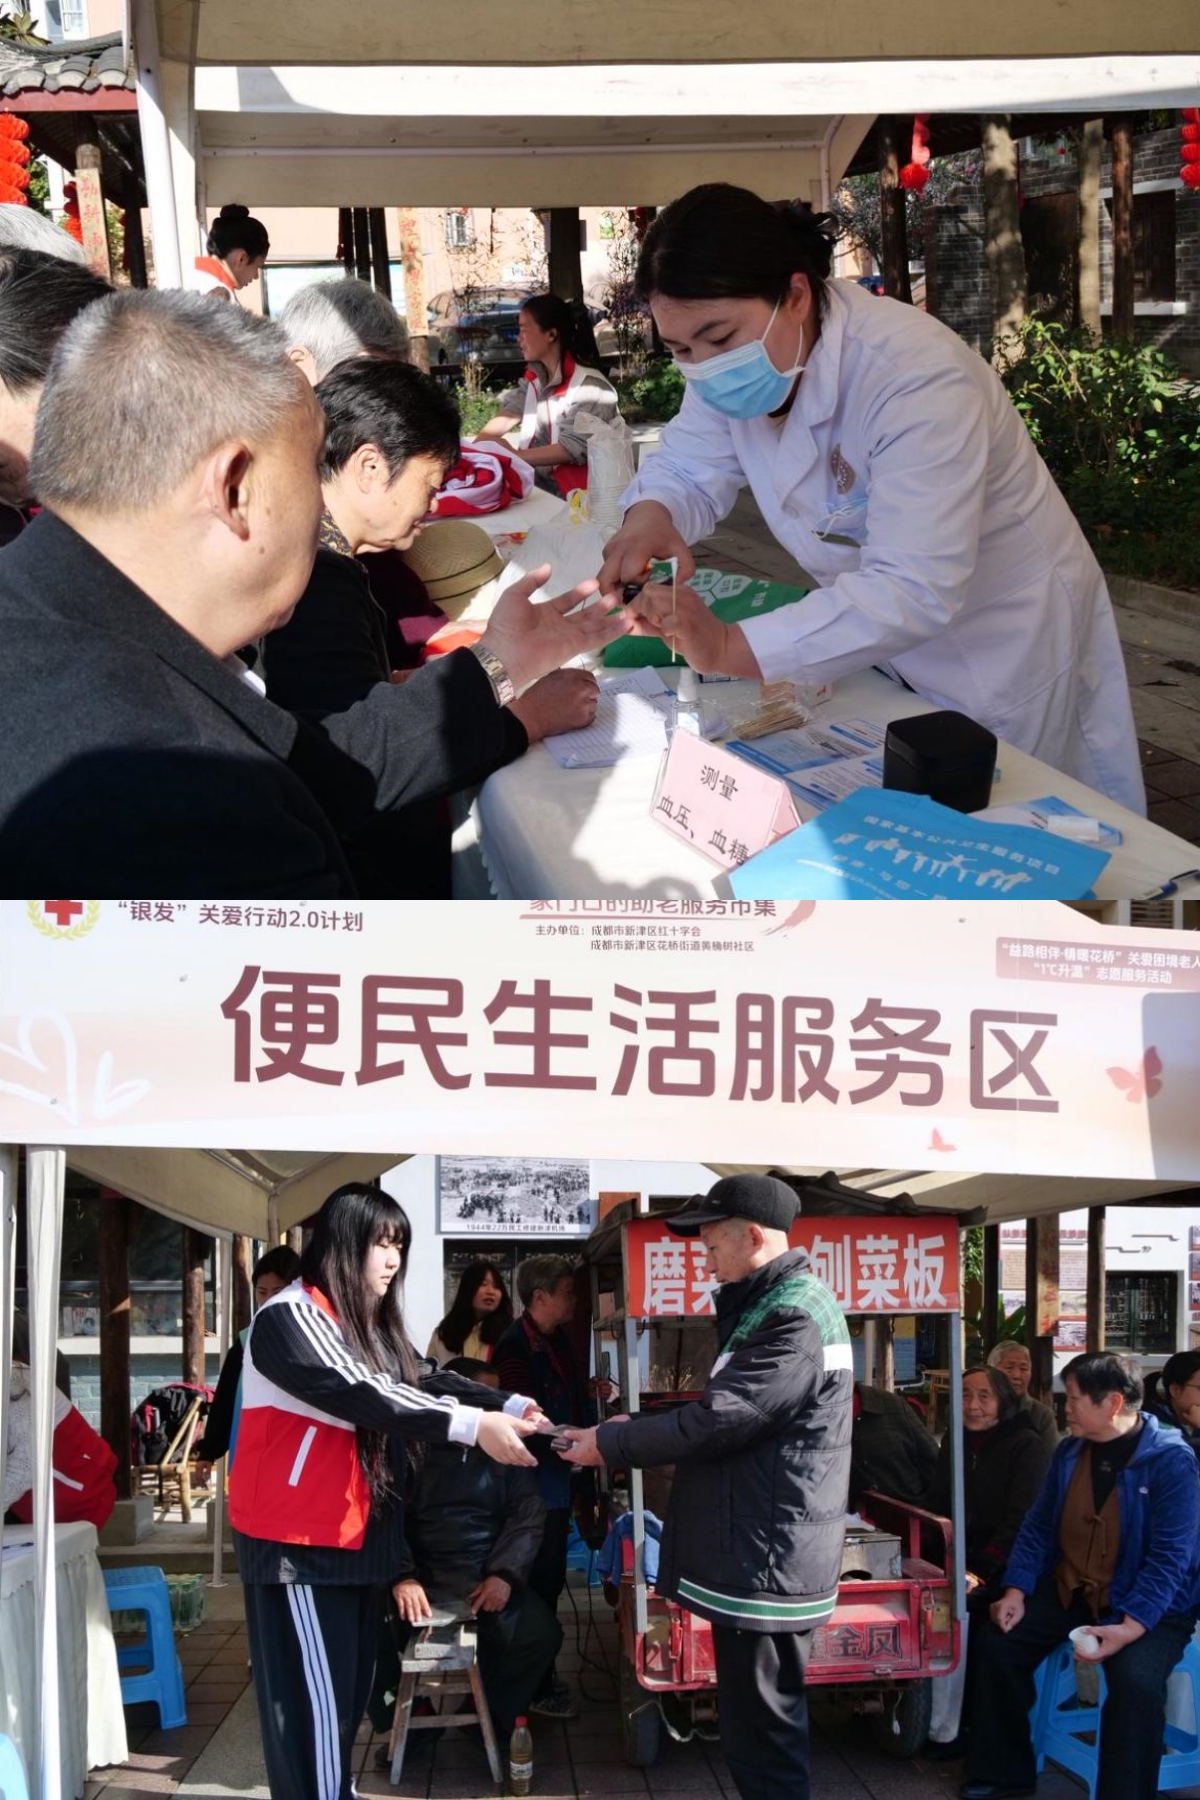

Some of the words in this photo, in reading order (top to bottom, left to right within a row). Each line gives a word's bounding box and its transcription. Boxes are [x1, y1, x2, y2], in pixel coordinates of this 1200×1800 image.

[700, 765, 738, 801] 测量
[220, 965, 1060, 1113] 便民生活服务区
